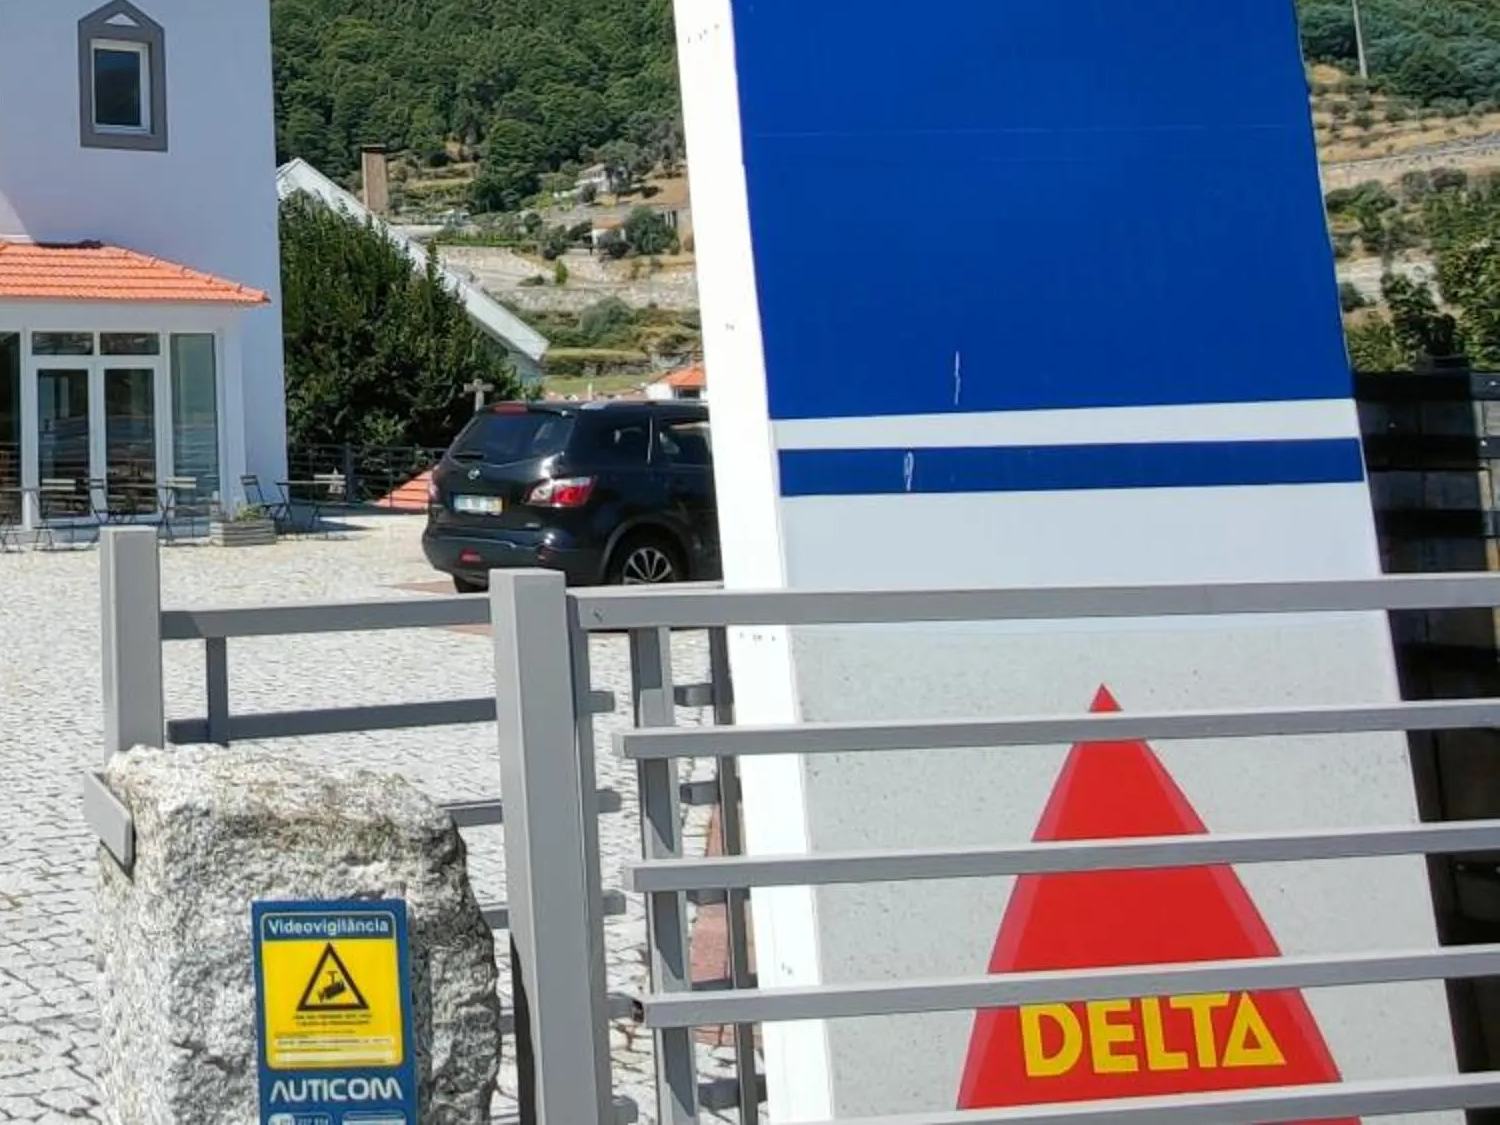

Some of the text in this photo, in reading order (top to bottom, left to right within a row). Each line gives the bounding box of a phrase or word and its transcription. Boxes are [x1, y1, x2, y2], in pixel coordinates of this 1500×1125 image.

[267, 918, 389, 936] Videovigilância
[1019, 991, 1286, 1076] DELTA
[270, 1077, 403, 1103] AUTICOM
